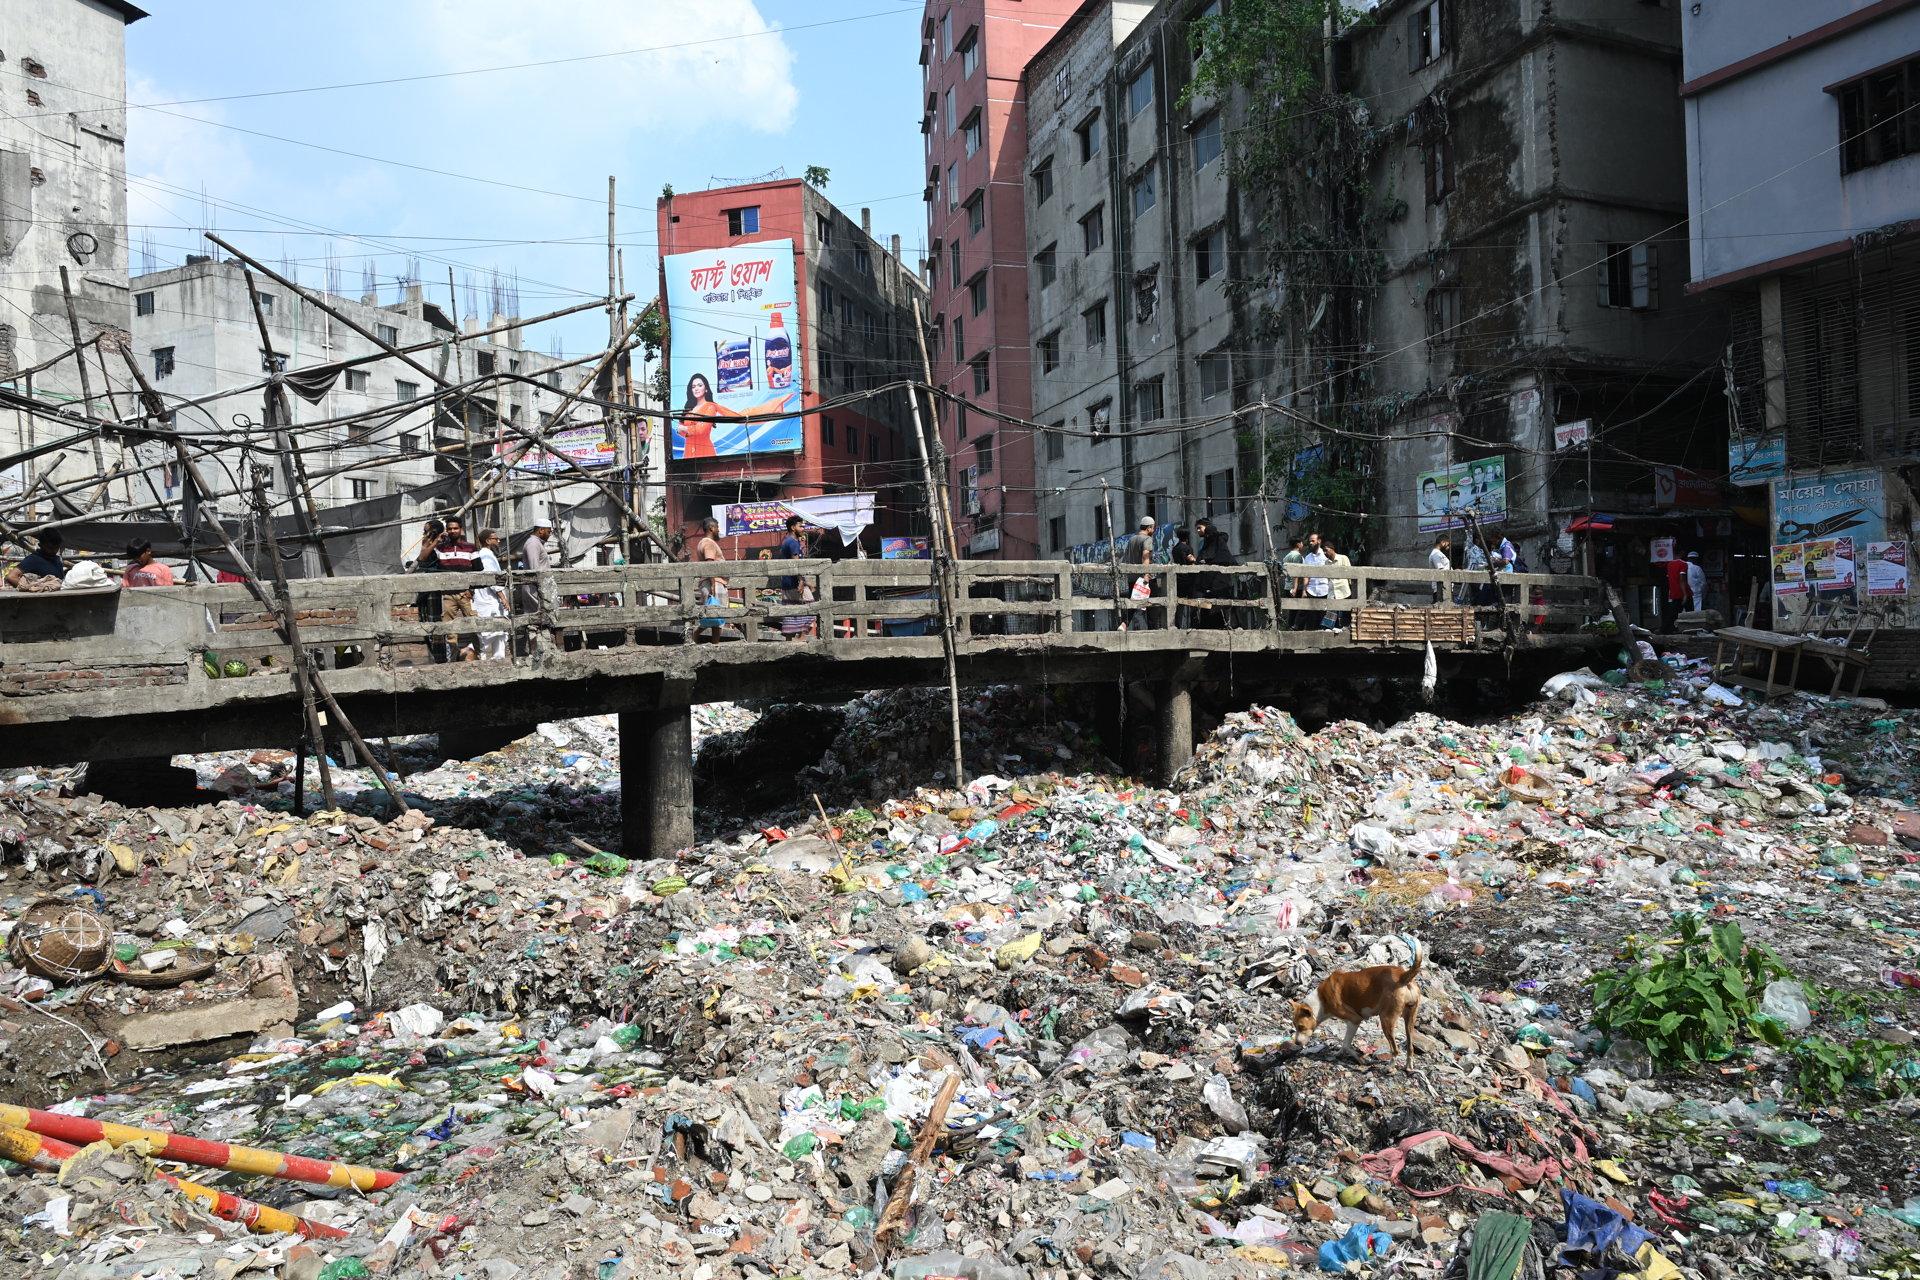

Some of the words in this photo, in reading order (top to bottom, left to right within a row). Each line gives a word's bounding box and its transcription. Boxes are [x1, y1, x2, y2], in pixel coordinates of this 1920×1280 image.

[690, 259, 727, 292] ফাস্ট
[730, 259, 774, 287] ওয়াশ
[718, 358, 732, 369] Fast
[733, 356, 749, 368] wash
[1777, 484, 1828, 502] মায়ের
[1833, 477, 1878, 495] দোয়া
